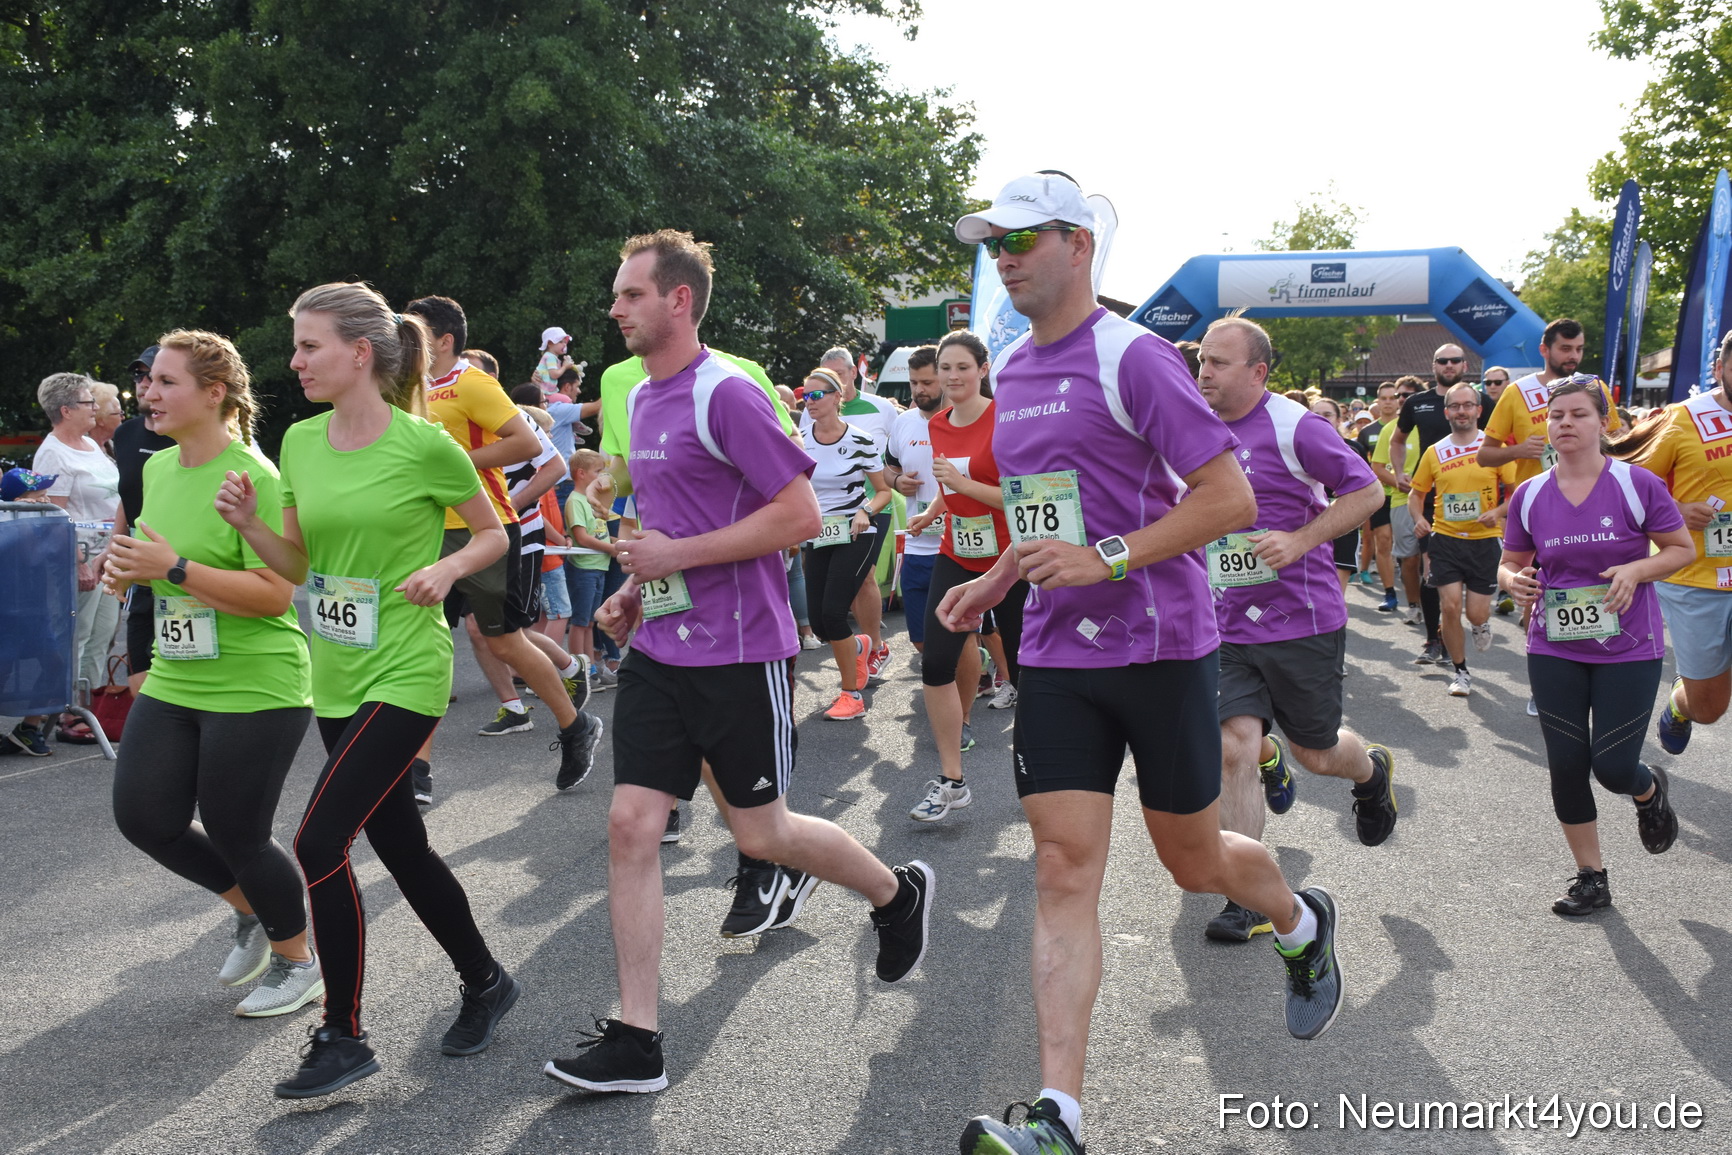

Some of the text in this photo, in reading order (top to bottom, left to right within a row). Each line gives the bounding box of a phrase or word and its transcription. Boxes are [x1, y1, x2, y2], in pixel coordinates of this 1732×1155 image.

[1298, 283, 1376, 298] firmenlauf
[1152, 311, 1193, 321] Fischer
[999, 401, 1070, 424] WIR SIND LILA.
[651, 450, 668, 460] LILA.
[1441, 460, 1465, 473] MAX
[1055, 493, 1073, 501] 2019
[1448, 502, 1476, 514] 1644
[1015, 503, 1060, 534] 878
[958, 531, 983, 547] 515
[1545, 532, 1619, 548] WIR SIND LILA.
[1220, 552, 1257, 572] 890
[317, 598, 357, 628] 446
[1558, 605, 1600, 627] 903
[162, 620, 195, 643] 451
[331, 625, 356, 636] Vanessa
